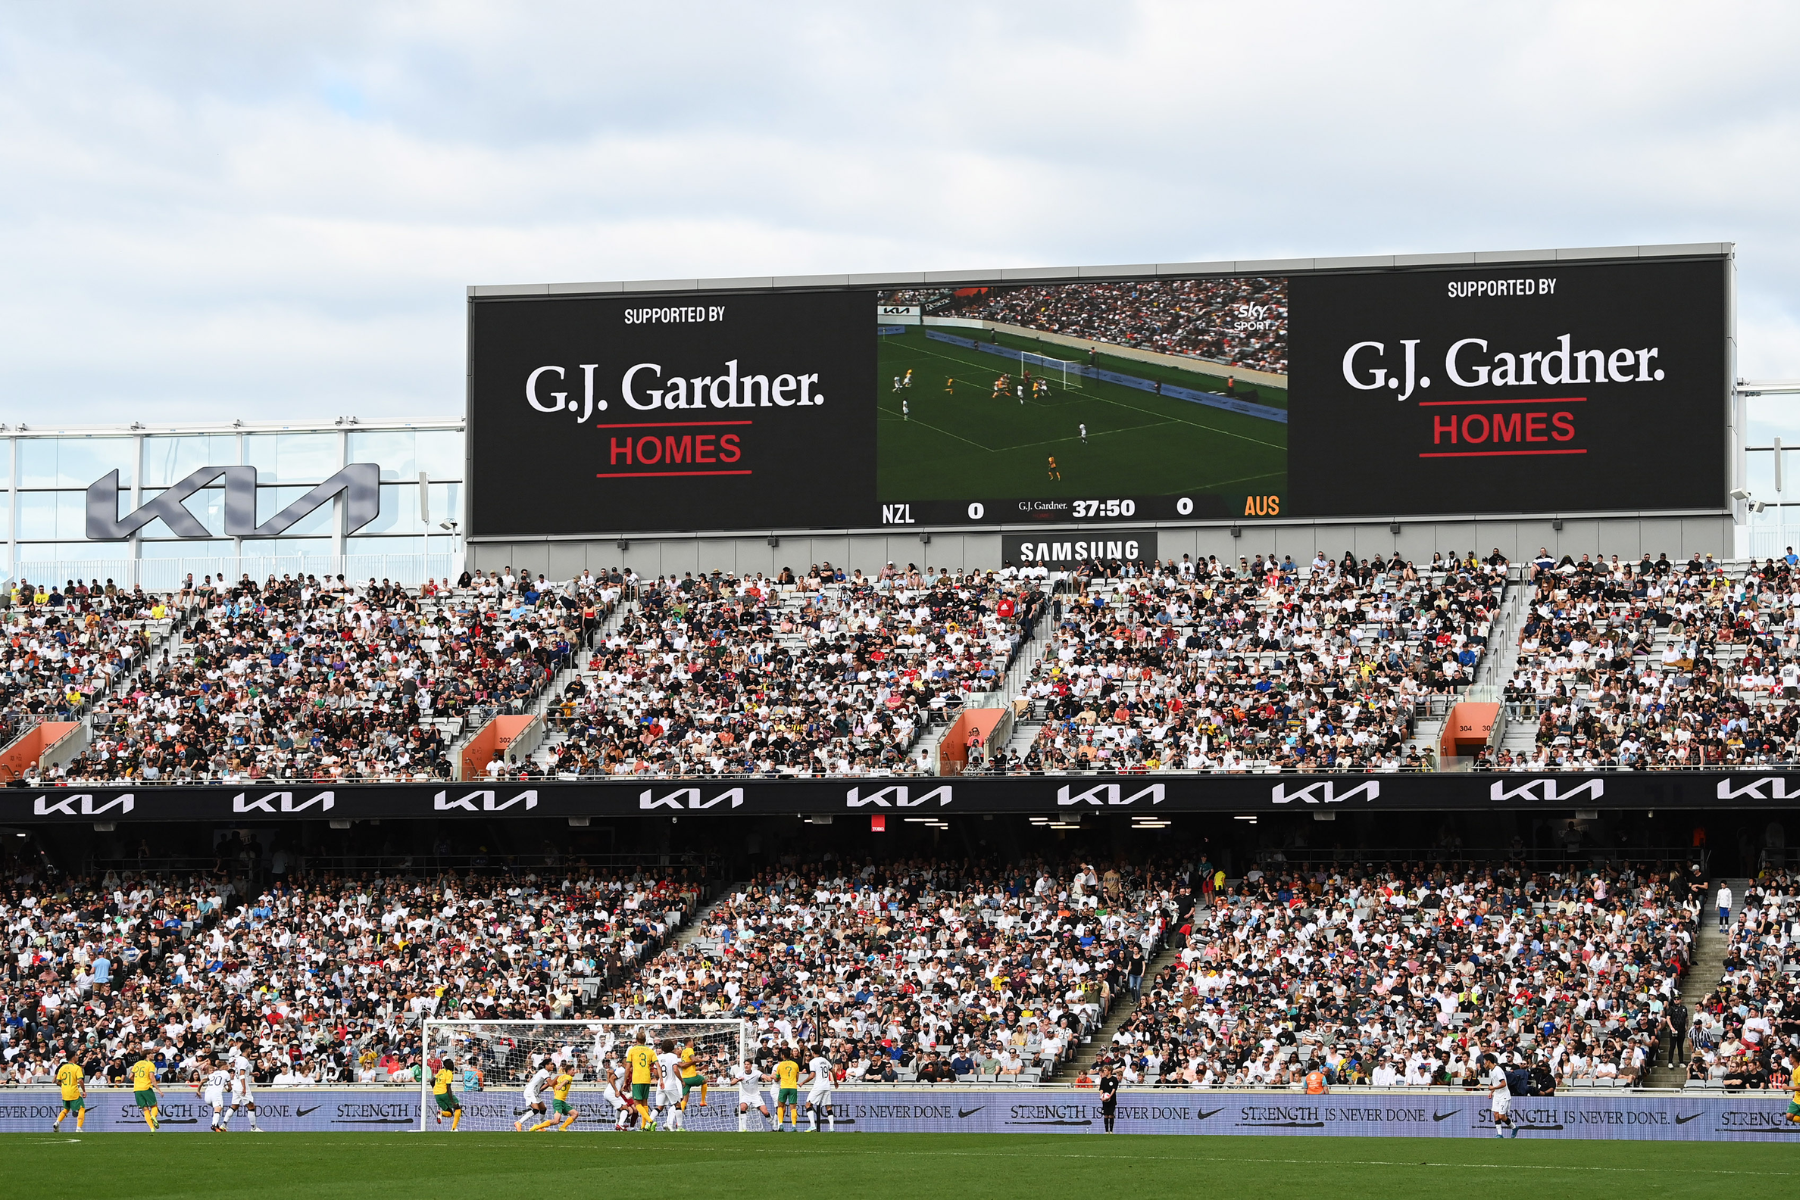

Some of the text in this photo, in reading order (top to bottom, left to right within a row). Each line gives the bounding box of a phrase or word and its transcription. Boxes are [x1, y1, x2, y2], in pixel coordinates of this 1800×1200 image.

[1447, 278, 1557, 298] SUPPORTED BY
[624, 305, 726, 325] SUPPORTED BY
[1238, 302, 1269, 320] sky
[1234, 321, 1270, 331] SPORT
[1342, 333, 1665, 402] G.J. Gardner.
[525, 358, 825, 424] G.J. Gardner.
[1433, 411, 1576, 445] HOMES
[610, 433, 742, 466] HOMES
[882, 503, 915, 525] NZL
[967, 503, 985, 520] 0
[1072, 498, 1136, 518] 37:50
[1176, 497, 1194, 516] 0
[1244, 495, 1280, 516] AUS
[1020, 540, 1139, 562] SAMSUNG
[639, 1053, 647, 1067] 3
[61, 1072, 72, 1086] 21
[134, 1066, 145, 1078] 26
[210, 1075, 222, 1086] 20
[820, 1065, 829, 1078] 19
[198, 1105, 209, 1118] IS
[254, 1105, 292, 1117] DONE.
[337, 1104, 409, 1118] STRENGTH
[855, 1105, 867, 1118] IS
[869, 1105, 911, 1119] NEVER
[913, 1105, 954, 1119] DONE.
[1010, 1104, 1087, 1119] STRENGTH
[1152, 1107, 1193, 1120] DONE.
[1241, 1106, 1428, 1123] STRENGTH IS NEVER DONE.
[1478, 1108, 1671, 1126] STENGTH IS NEVER DONE.
